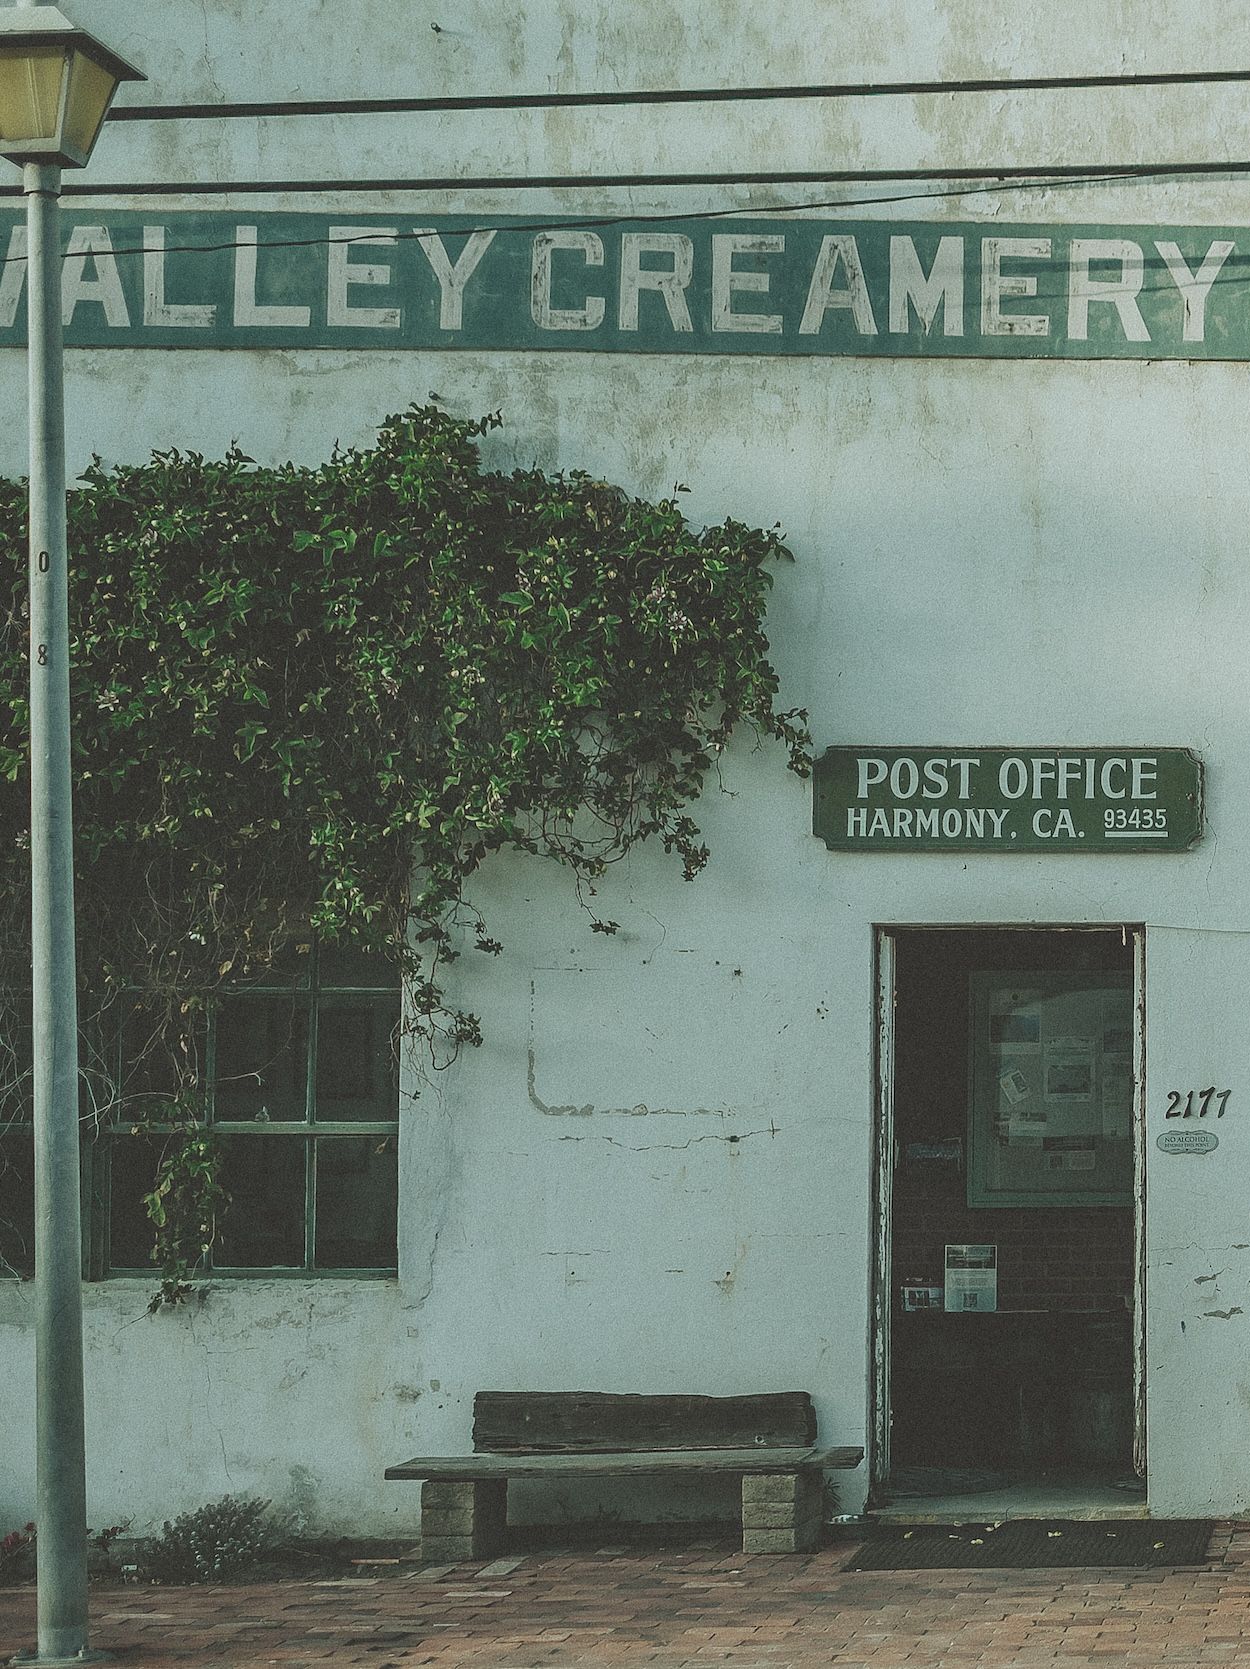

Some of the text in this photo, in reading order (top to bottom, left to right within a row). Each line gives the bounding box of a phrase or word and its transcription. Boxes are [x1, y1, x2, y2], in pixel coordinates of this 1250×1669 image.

[530, 232, 1236, 342] CREAMERY
[855, 757, 1158, 800] POST OFFICE
[1031, 808, 1085, 838] CA.
[1103, 808, 1167, 830] 93435
[1165, 1086, 1232, 1119] 2177
